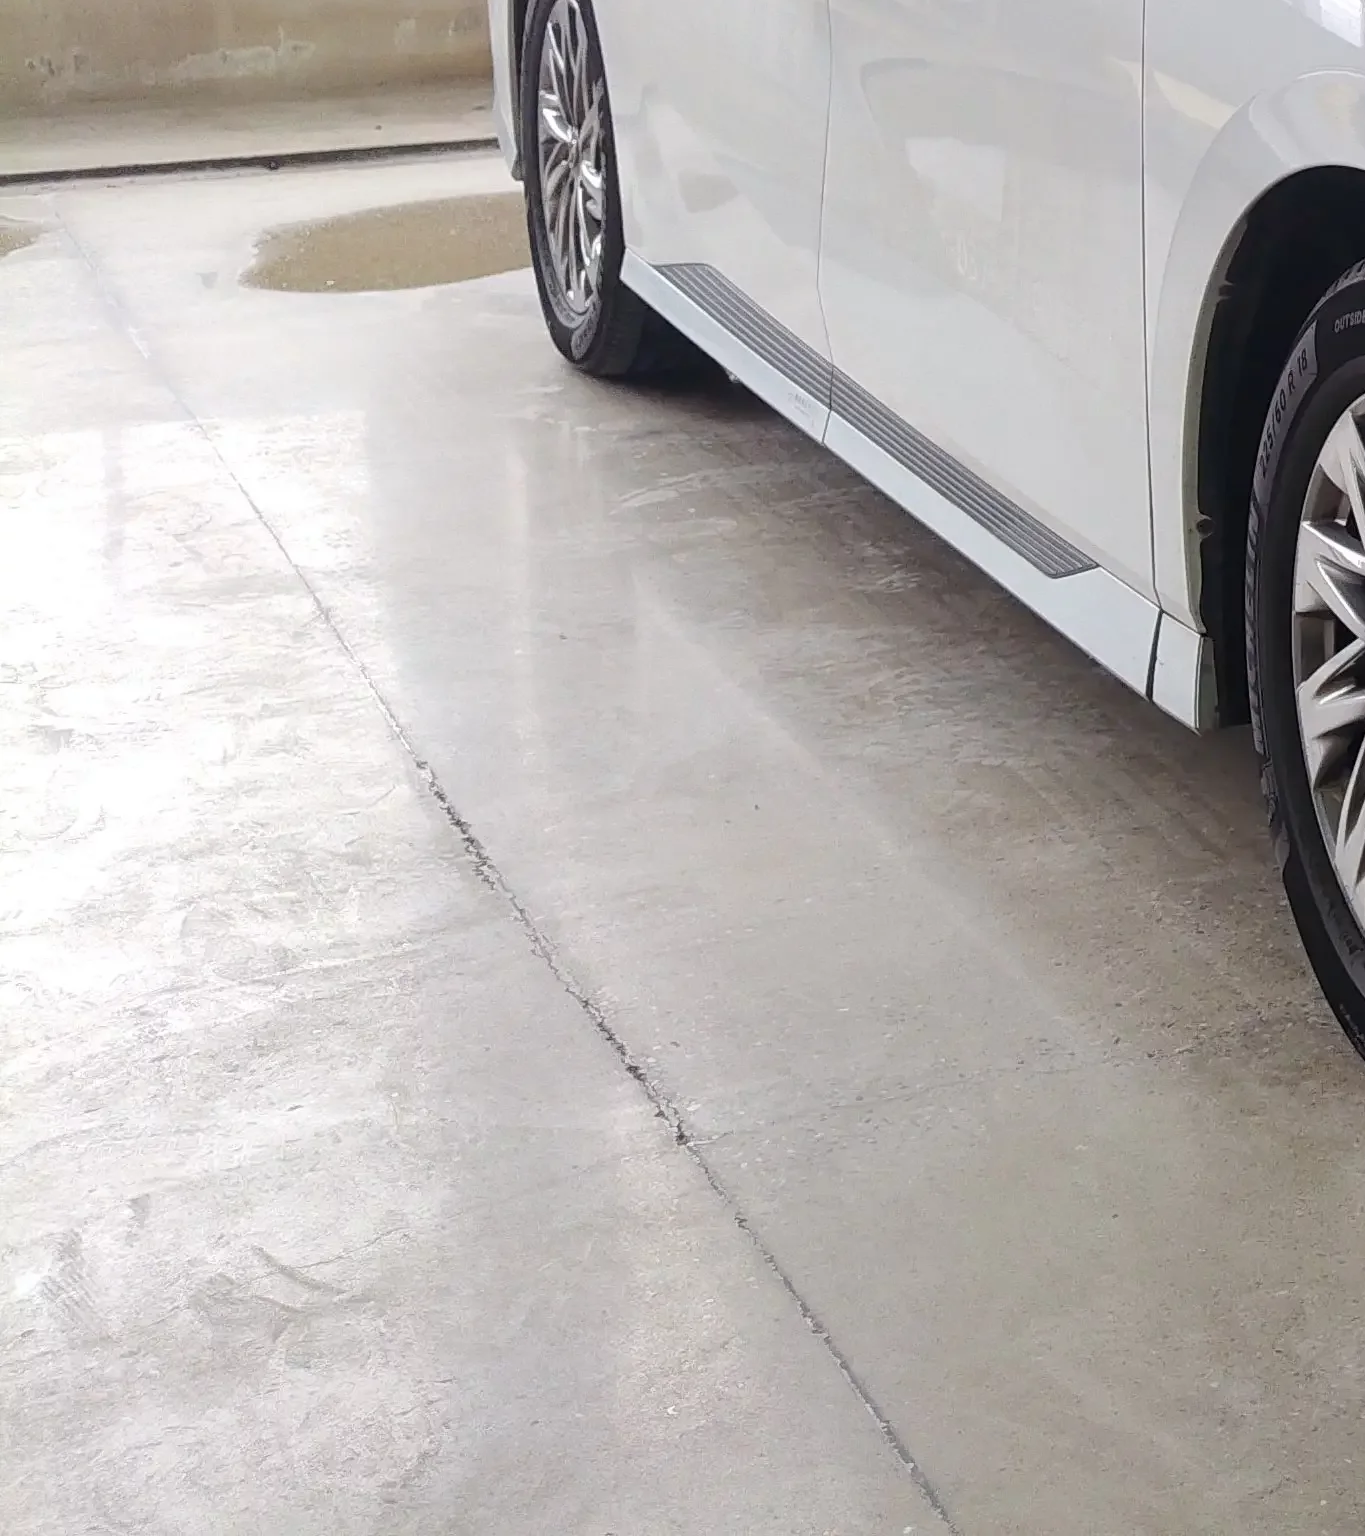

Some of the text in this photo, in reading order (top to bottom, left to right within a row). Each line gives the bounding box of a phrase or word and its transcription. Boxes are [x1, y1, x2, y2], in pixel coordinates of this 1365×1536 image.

[1258, 347, 1309, 480] 225/60 R 18
